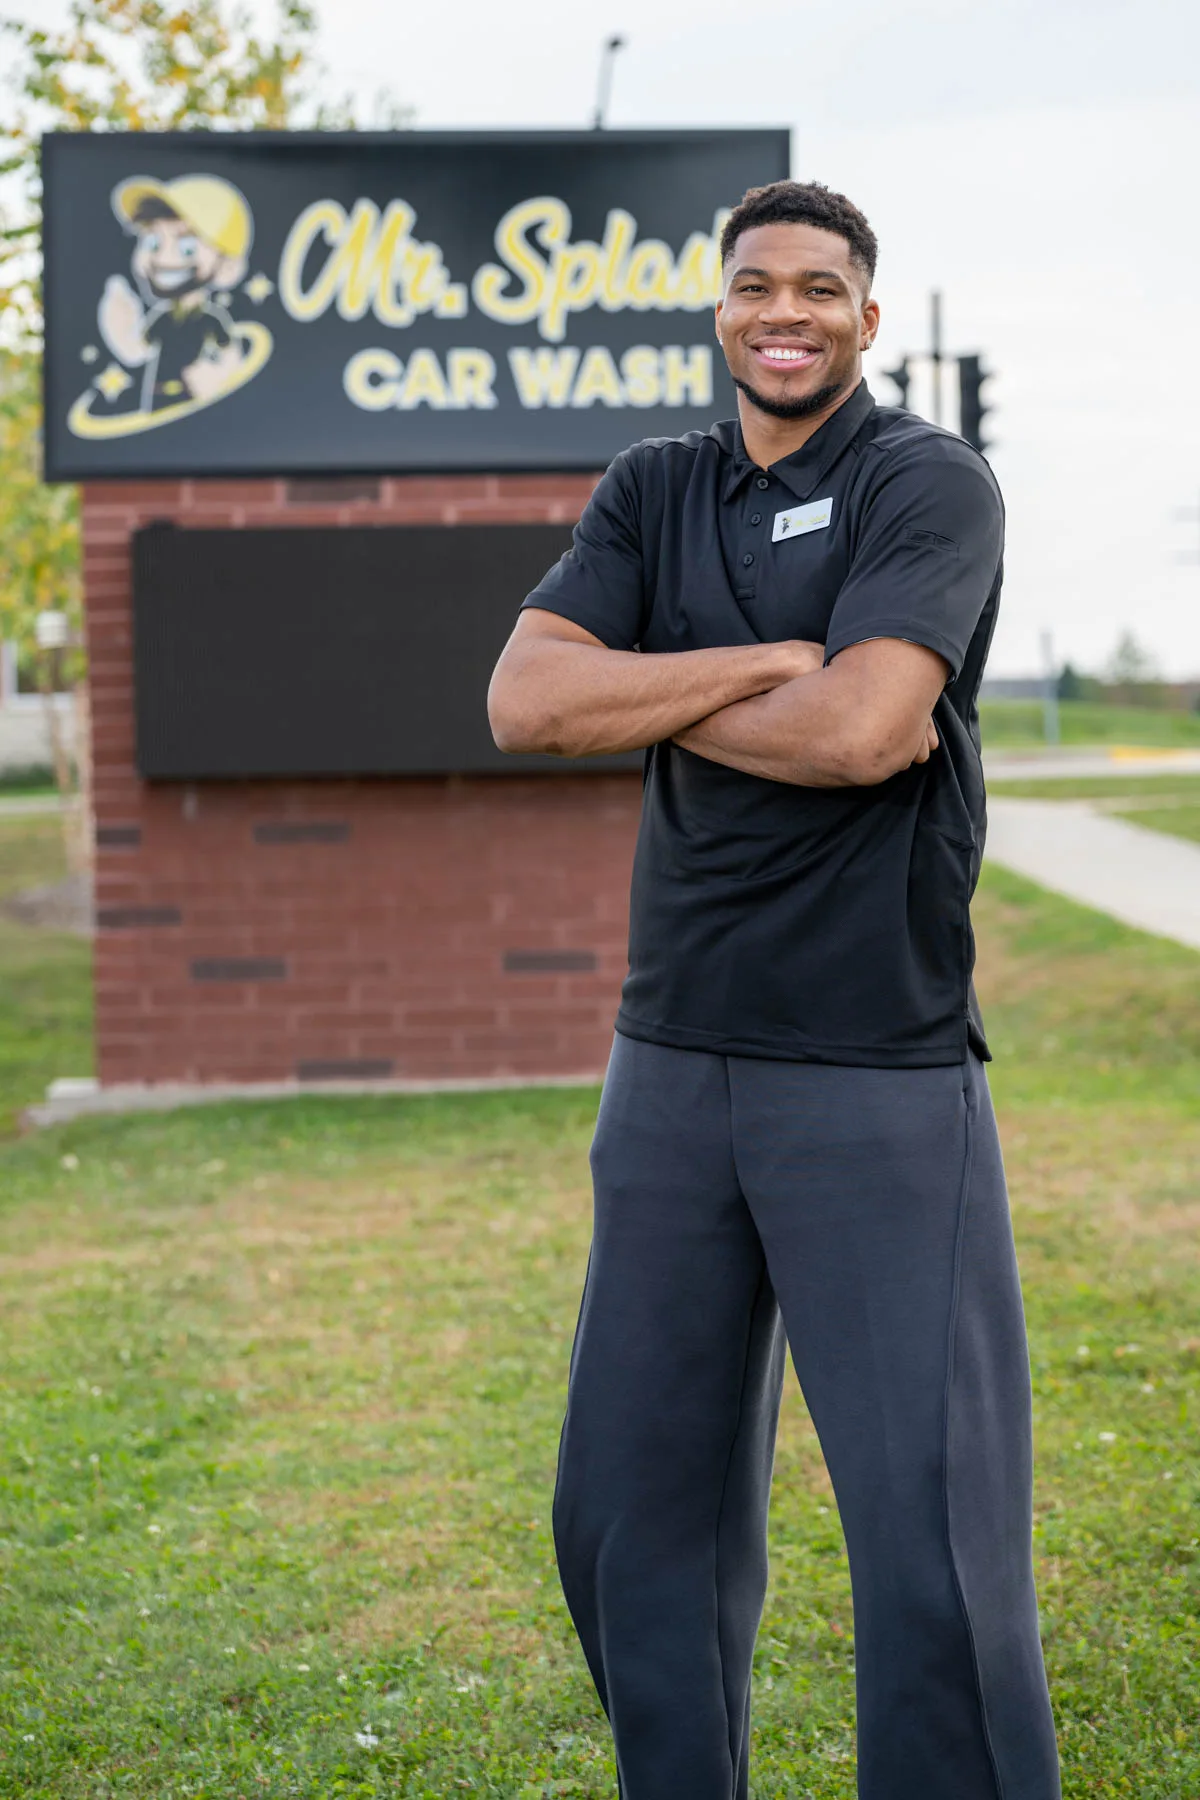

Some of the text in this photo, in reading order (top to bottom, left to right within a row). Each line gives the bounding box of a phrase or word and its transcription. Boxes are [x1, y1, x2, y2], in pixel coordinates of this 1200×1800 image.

[279, 198, 468, 328] Mr.
[343, 345, 714, 411] CAR WASH
